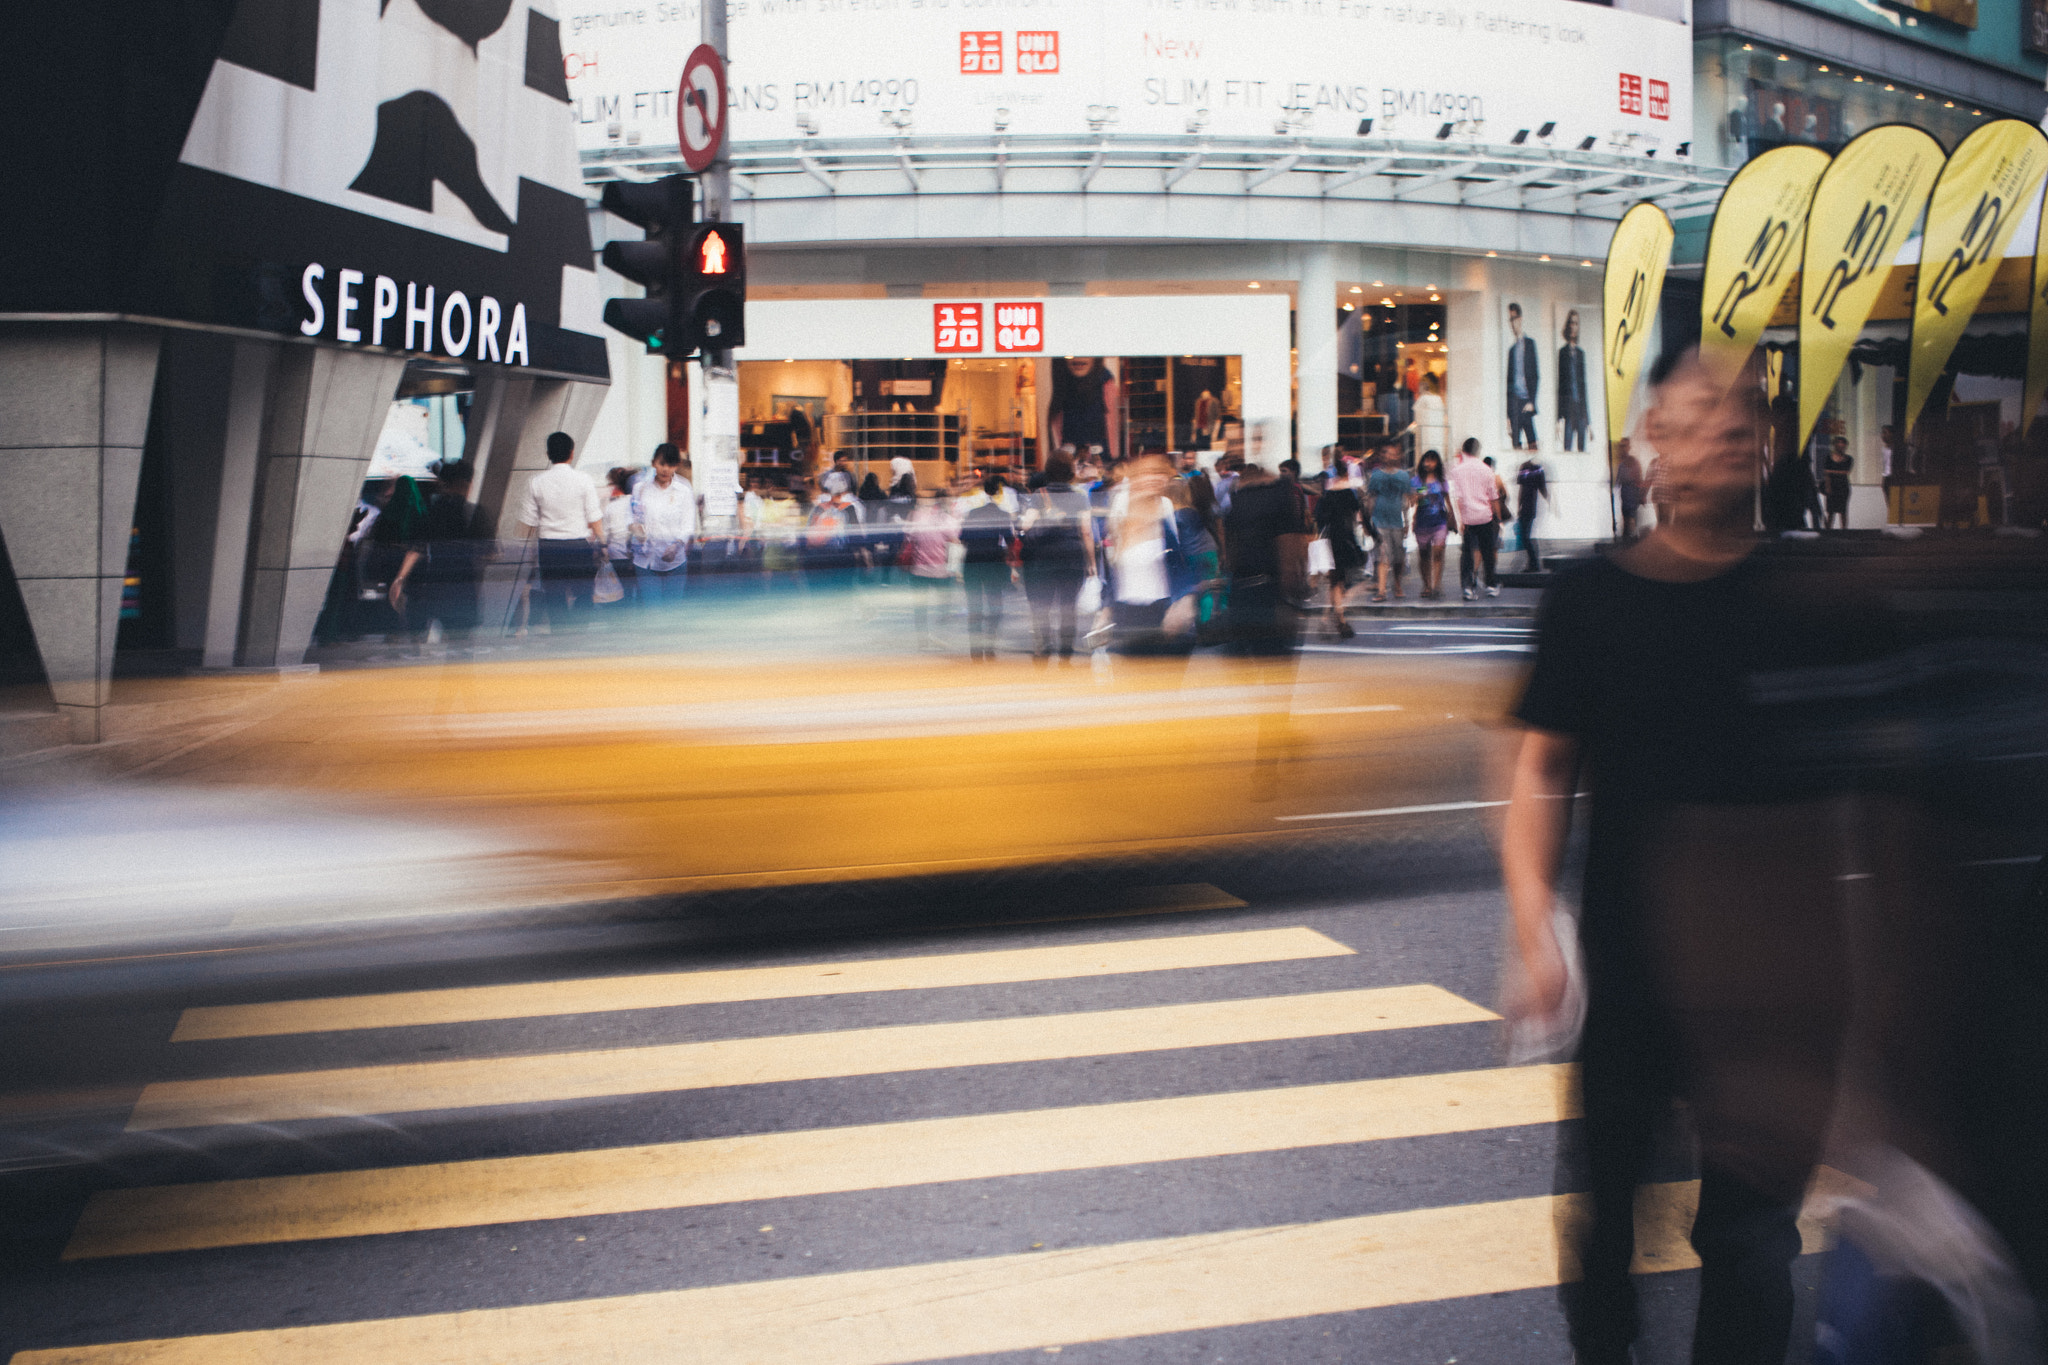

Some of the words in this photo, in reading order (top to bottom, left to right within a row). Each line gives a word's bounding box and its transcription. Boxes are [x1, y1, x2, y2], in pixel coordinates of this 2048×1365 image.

[573, 9, 646, 36] genuine
[1144, 31, 1204, 59] New
[573, 95, 620, 123] LIM
[633, 90, 677, 119] FIT
[1145, 77, 1210, 106] SLIM
[1224, 80, 1268, 108] FIT
[1277, 82, 1368, 114] JEANS
[300, 262, 529, 366] SEPHORA
